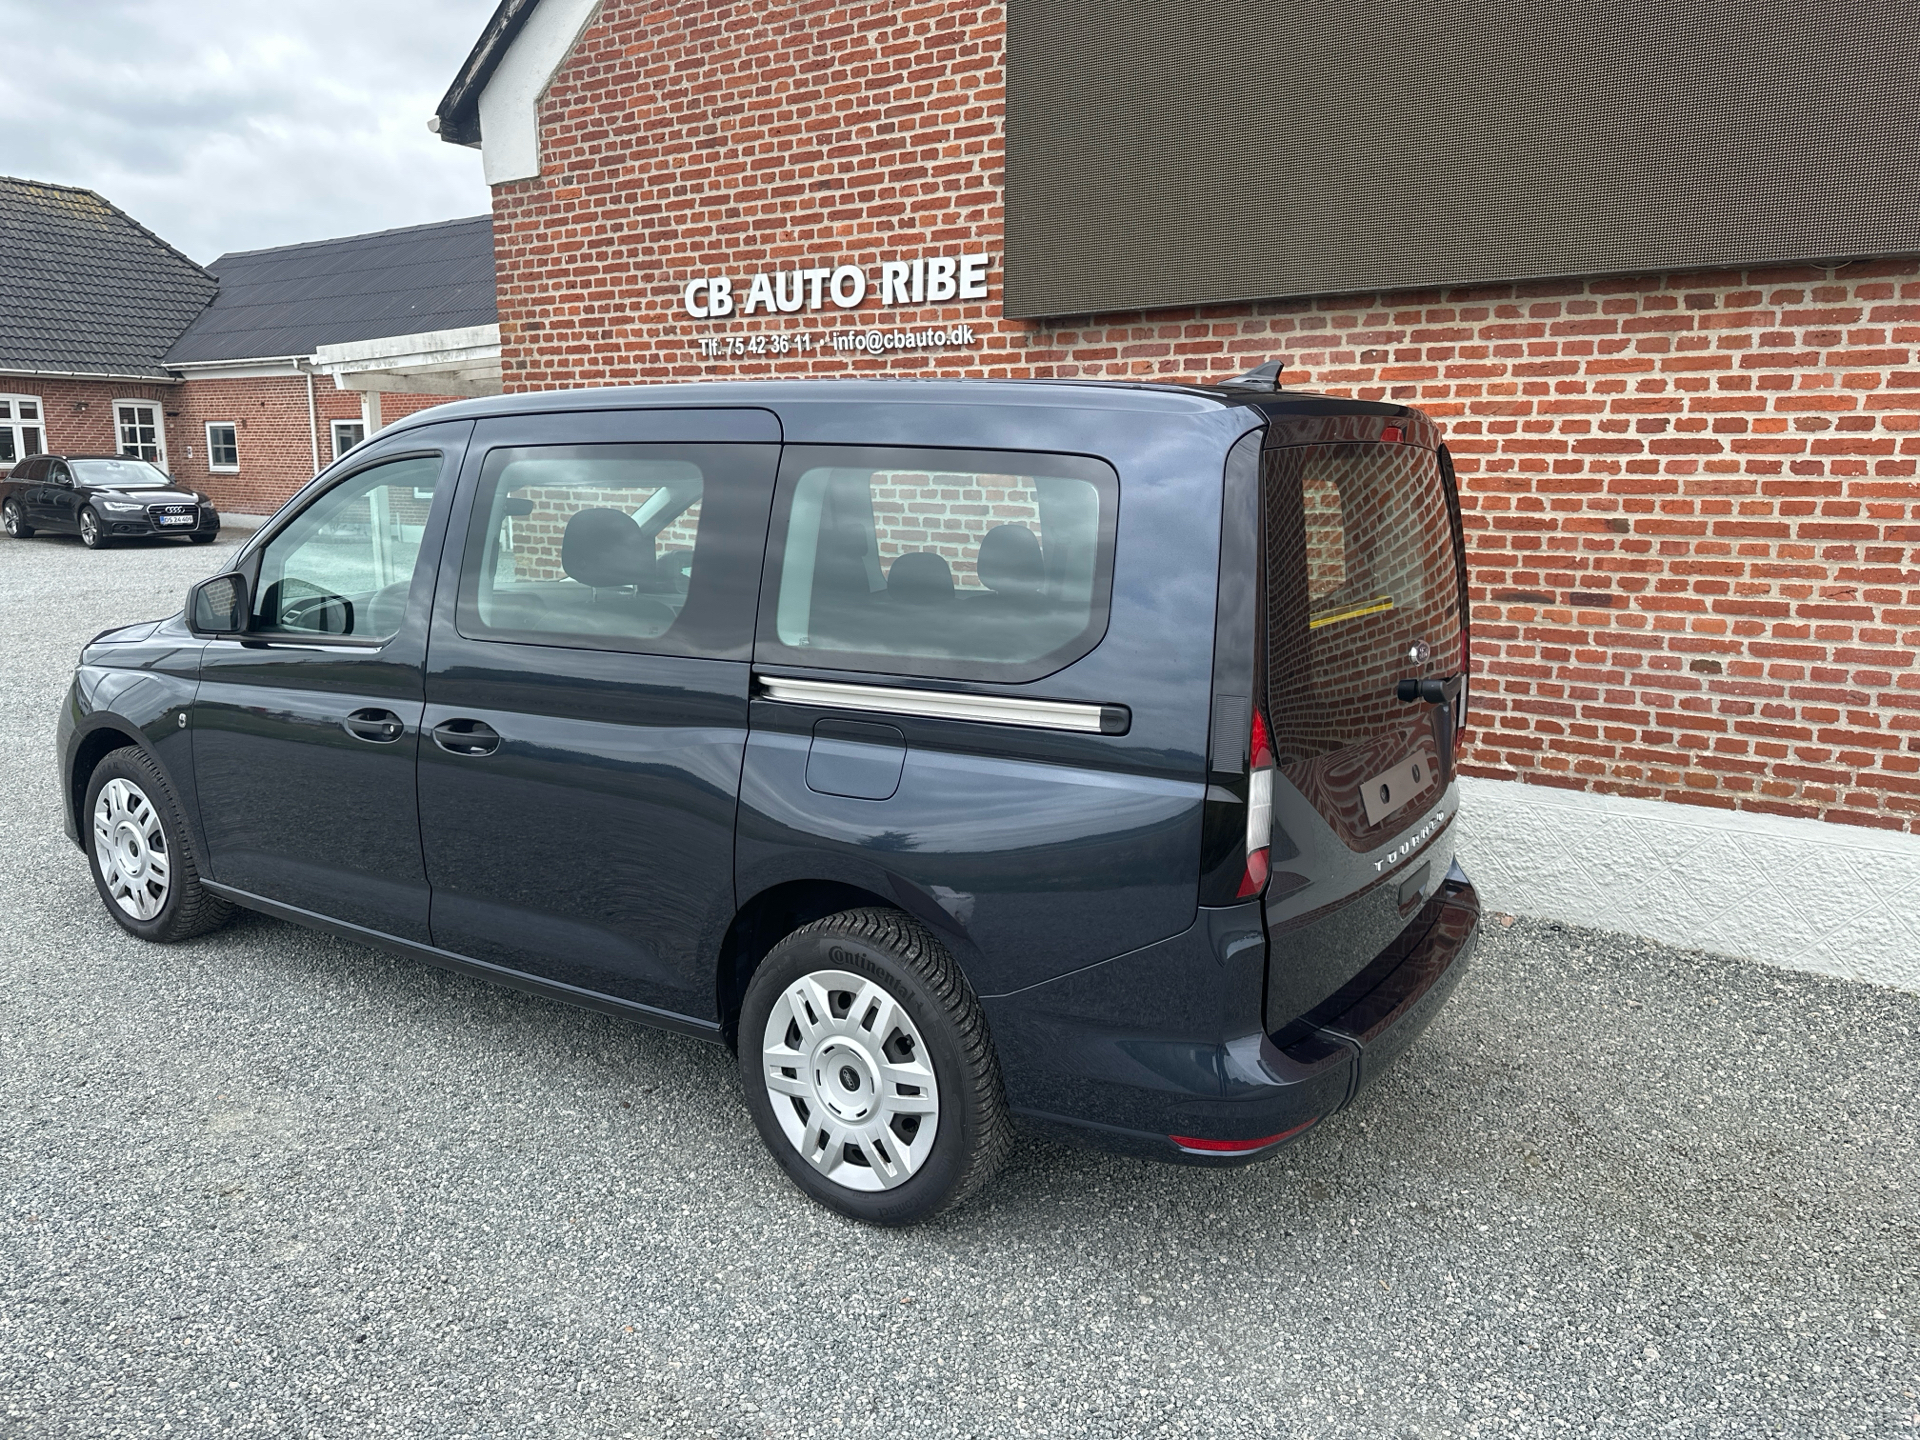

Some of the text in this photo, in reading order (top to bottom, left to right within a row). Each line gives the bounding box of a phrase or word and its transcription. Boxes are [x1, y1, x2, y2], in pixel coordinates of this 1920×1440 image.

[684, 252, 989, 318] CB AUTO RIBE
[698, 324, 975, 357] Tlf. 75 42 36 11 info@cbauto.dk
[828, 945, 916, 1004] Continental
